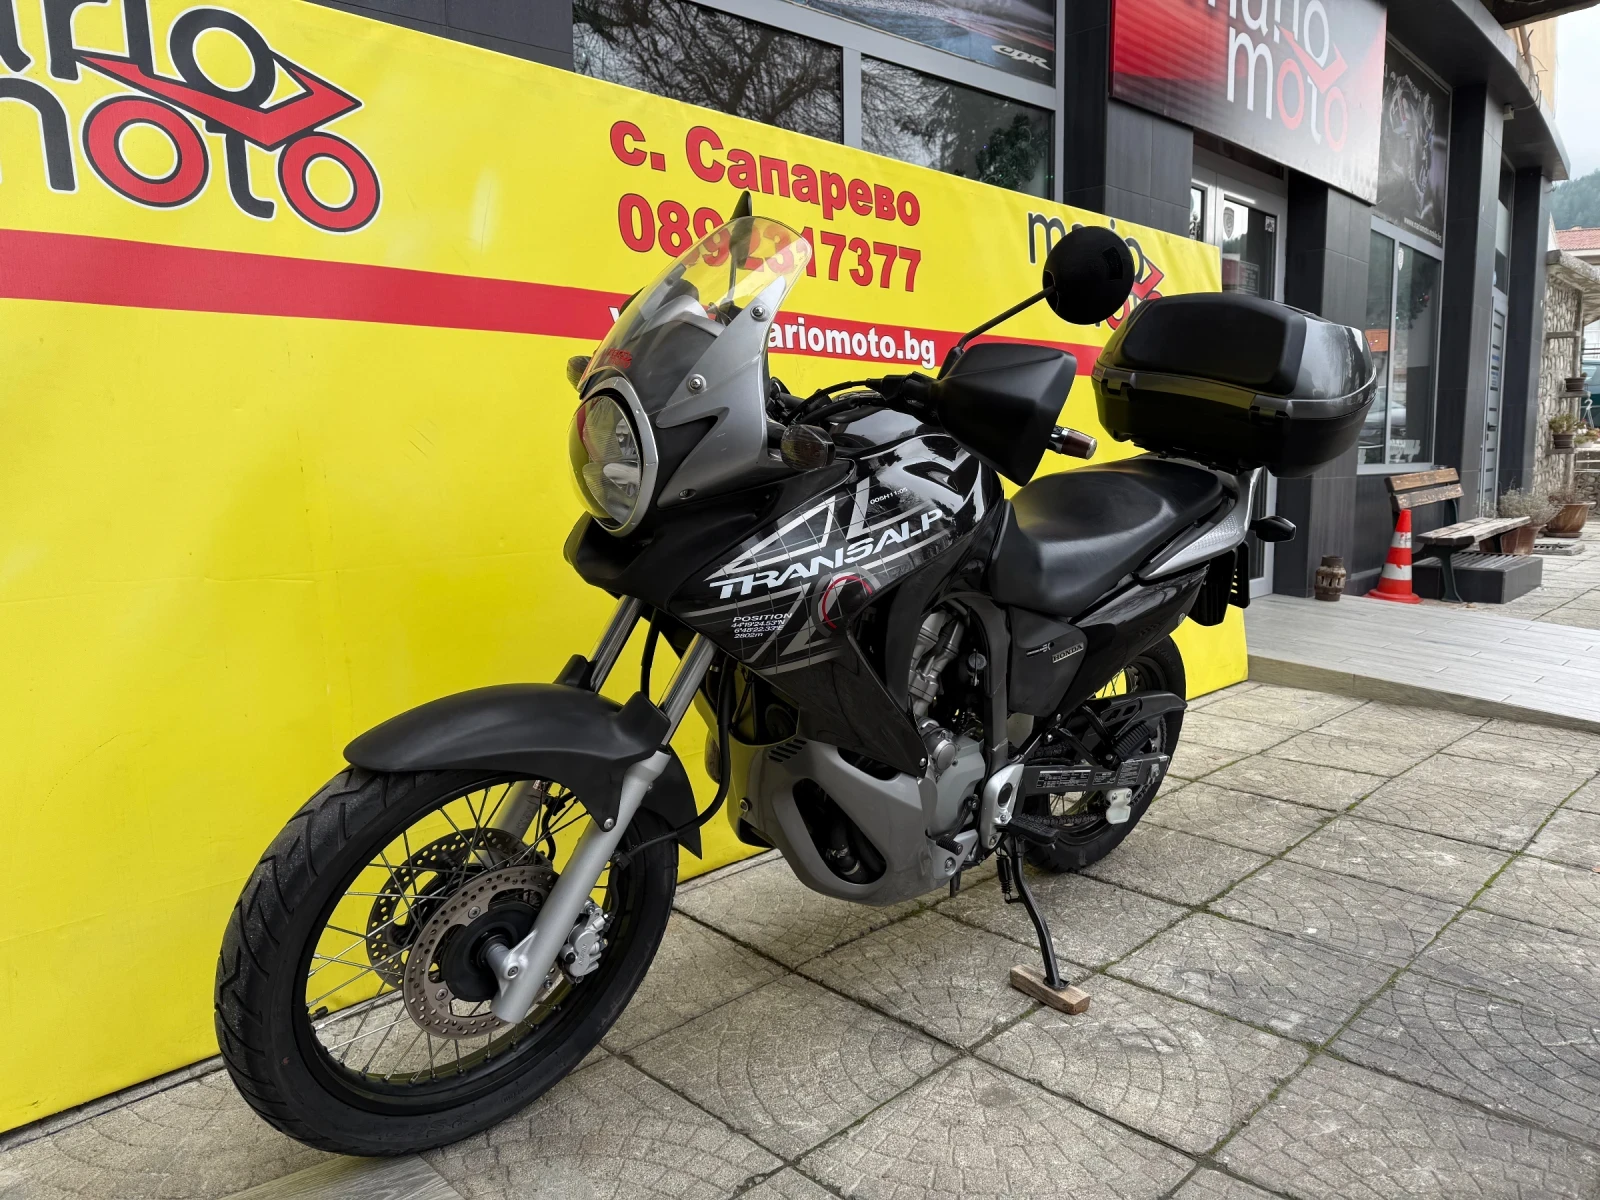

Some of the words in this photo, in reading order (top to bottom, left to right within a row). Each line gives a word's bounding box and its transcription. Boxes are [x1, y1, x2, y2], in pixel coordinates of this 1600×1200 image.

[991, 45, 1052, 70] CBR
[1226, 26, 1348, 152] moto
[610, 120, 666, 172] с.
[686, 126, 920, 226] Сапарево
[709, 508, 943, 599] TRANSALP
[732, 612, 793, 623] POSITION
[1052, 643, 1084, 663] HONDA
